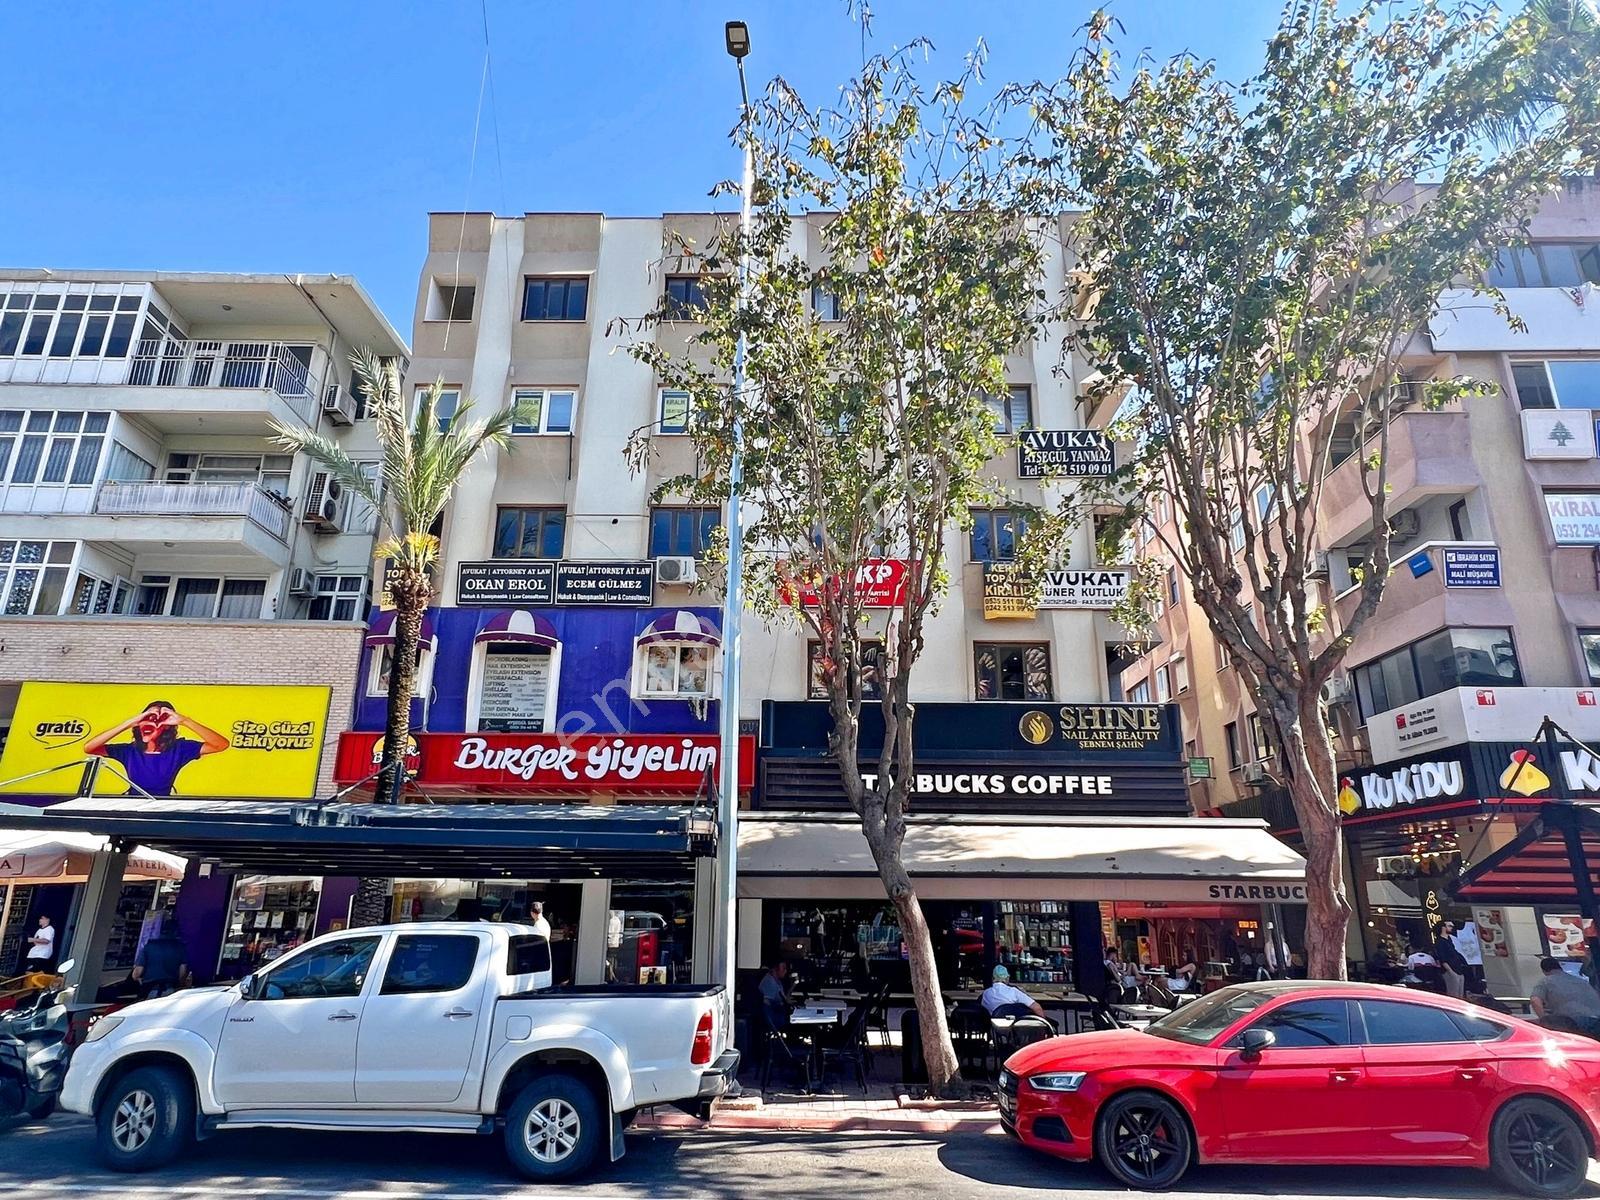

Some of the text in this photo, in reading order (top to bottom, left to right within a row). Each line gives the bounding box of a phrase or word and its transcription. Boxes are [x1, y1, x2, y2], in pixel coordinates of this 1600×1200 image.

[1025, 431, 1106, 449] AVUKAT
[1070, 450, 1112, 462] YANMAZ
[1069, 463, 1087, 475] 519
[1088, 463, 1100, 474] 09
[1101, 463, 1112, 473] 01
[1556, 524, 1581, 538] 0532
[559, 566, 651, 575] AVUKAT ATTORNEY AT LAW
[847, 565, 893, 584] KP
[465, 578, 546, 590] OKAN EROL
[566, 578, 642, 589] ECEM GÜLMEZ
[985, 584, 1033, 597] KİRALI
[1042, 587, 1075, 597] ÜNER
[1060, 706, 1161, 730] SHINE
[36, 719, 84, 735] gratis
[231, 719, 314, 735] Size Güzel
[231, 734, 314, 751] Bakıyoruz
[1061, 731, 1160, 741] NAIL ART BEAUTY
[1079, 740, 1145, 750] ŞEBNEM ŞAHİN
[861, 773, 1113, 795] TBUCKS COFFEE
[1208, 884, 1308, 900] STARBUC
